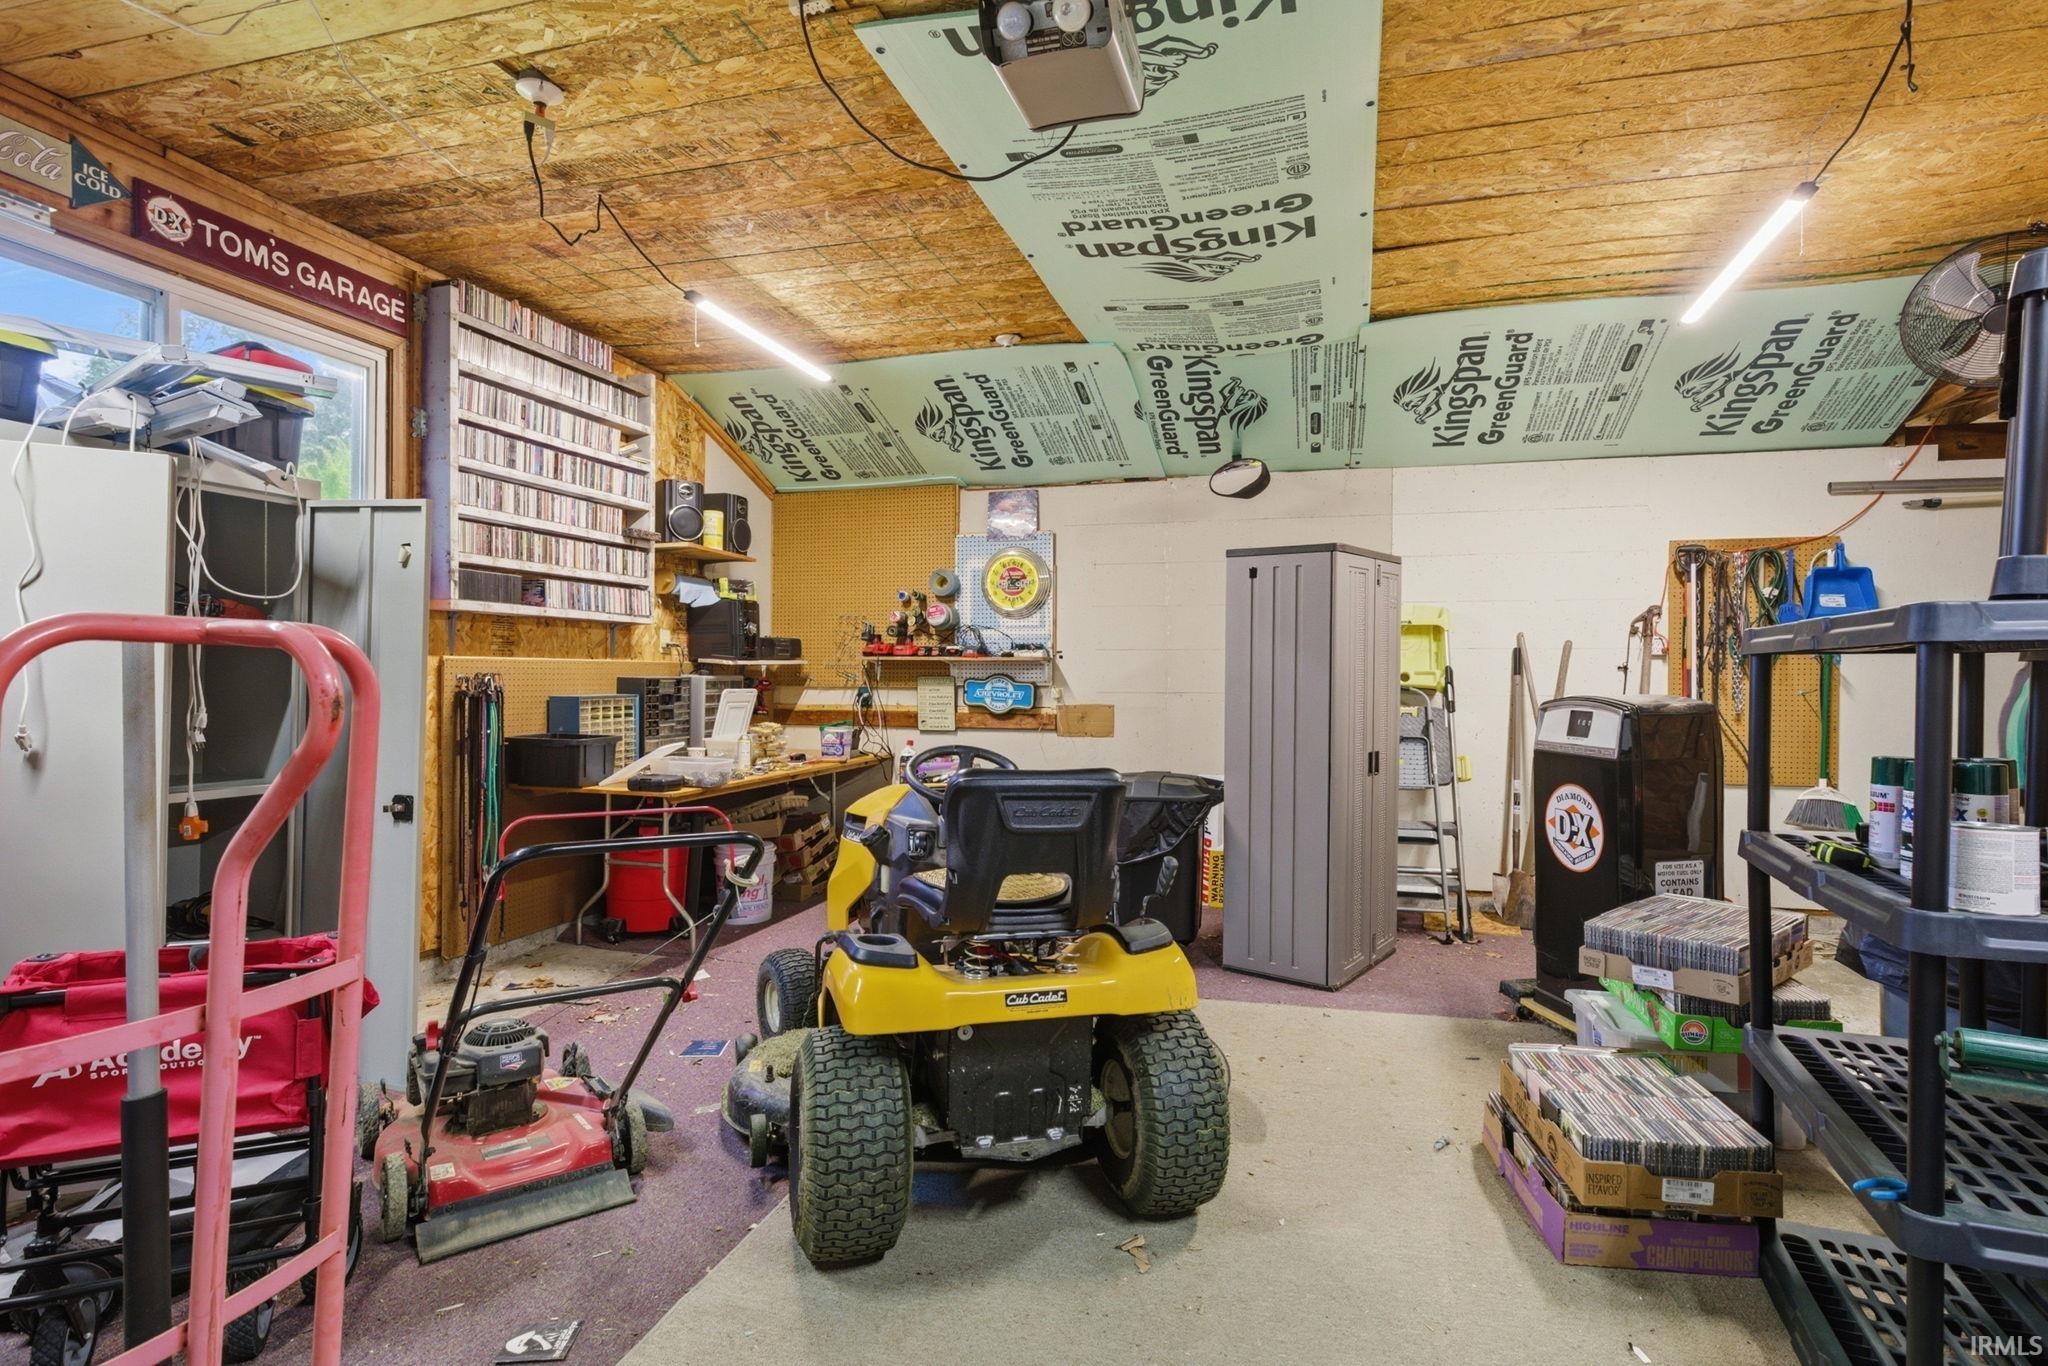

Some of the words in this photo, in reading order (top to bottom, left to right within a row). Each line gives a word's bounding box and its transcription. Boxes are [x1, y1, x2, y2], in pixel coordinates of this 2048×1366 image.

[82, 163, 109, 183] ICE
[74, 173, 121, 199] COLD
[197, 218, 290, 277] TOM'S
[297, 262, 405, 323] GARAGE
[1556, 792, 1593, 810] DIAMOND
[1211, 855, 1220, 902] WARNING
[1660, 878, 1699, 887] CONTAINS
[1006, 994, 1028, 1005] Cub
[1029, 991, 1065, 1003] Cadet
[1585, 1173, 1623, 1185] INSPIRED
[1588, 1184, 1621, 1196] FLAVOR
[1569, 1222, 1630, 1234] HIGHLINE
[1646, 1244, 1754, 1272] CHAMPIGNONS
